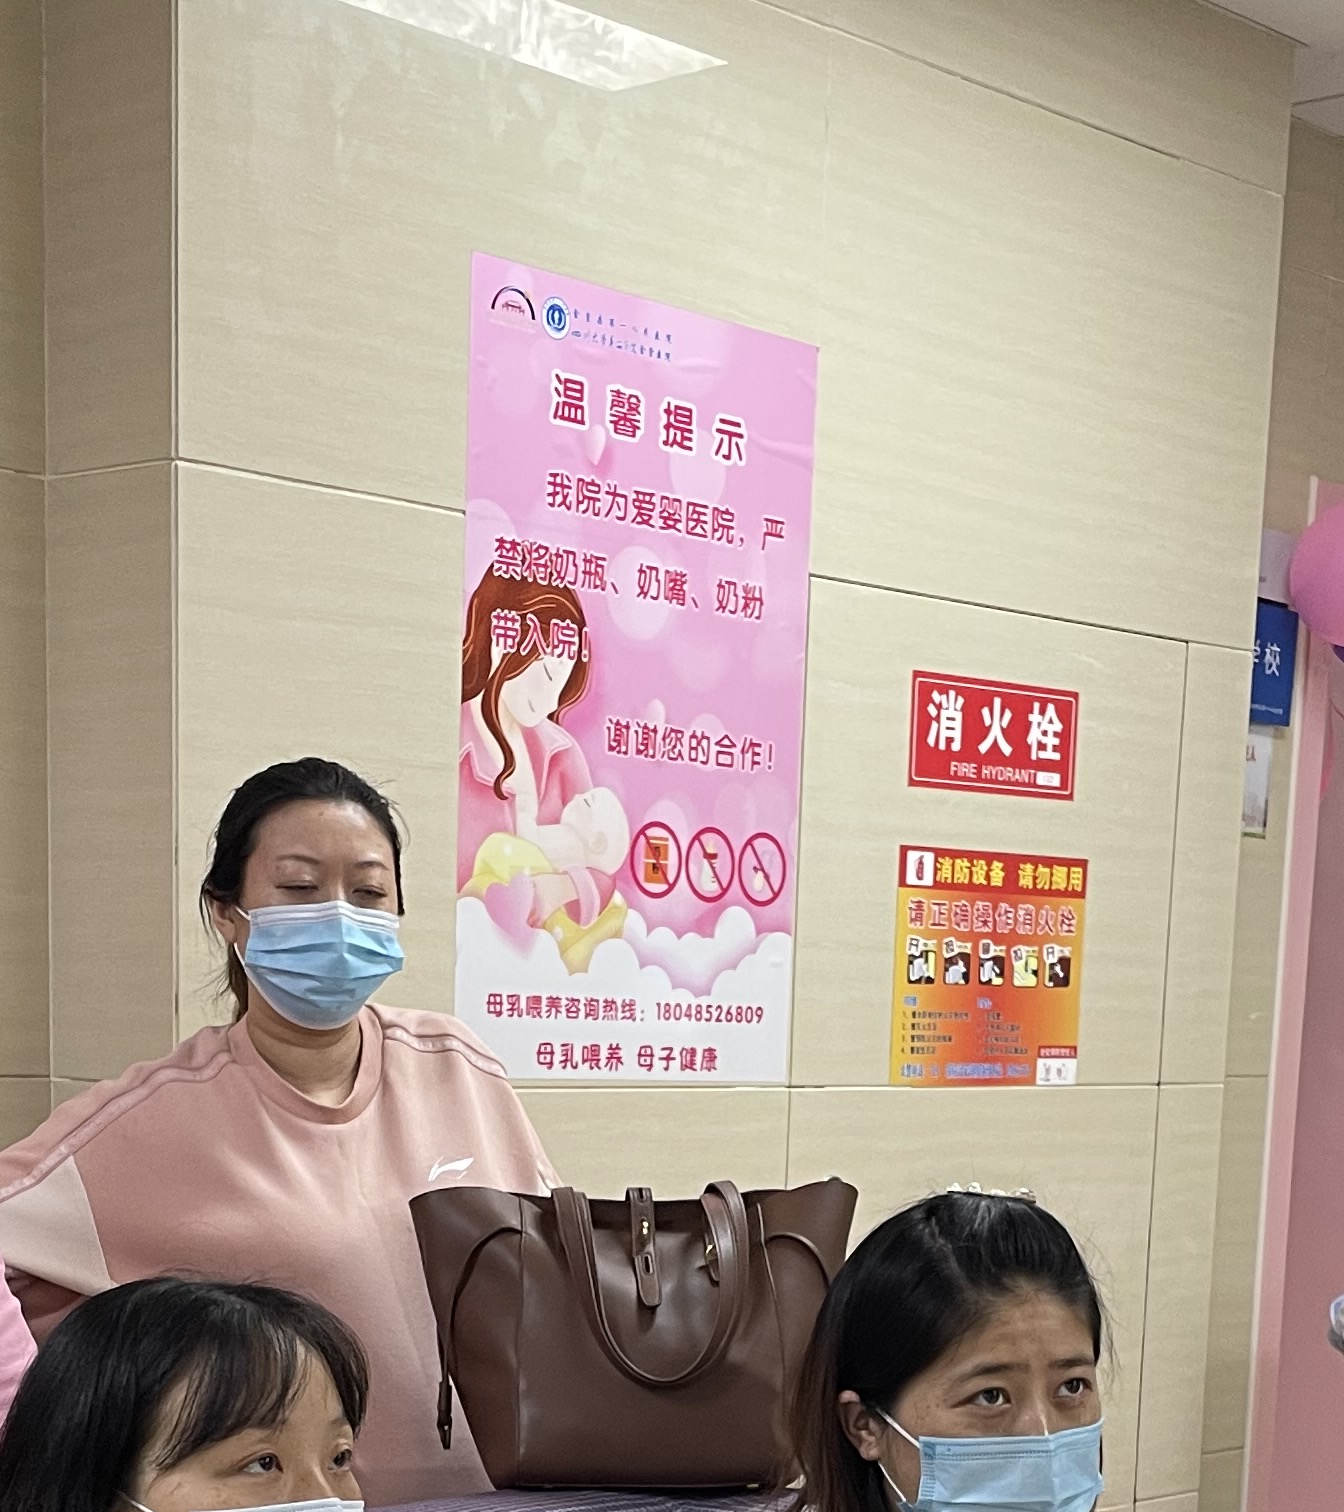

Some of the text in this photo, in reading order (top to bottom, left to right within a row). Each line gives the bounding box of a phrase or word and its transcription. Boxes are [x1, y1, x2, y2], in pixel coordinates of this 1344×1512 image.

[553, 373, 745, 462] 温馨提示
[546, 472, 785, 551] 我院为爱婴医院，严
[493, 537, 764, 620] 禁将奶瓶、奶嘴、奶粉
[606, 718, 773, 772] 谢谢您的合作!
[927, 690, 1063, 760] 消火栓
[950, 761, 1036, 784] FIRE HYDRANT
[936, 857, 1083, 892] 消防设备 请勿挪用
[907, 898, 1077, 936] 请正确操作消火栓
[536, 1042, 718, 1073] 母乳喂养 母子健康
